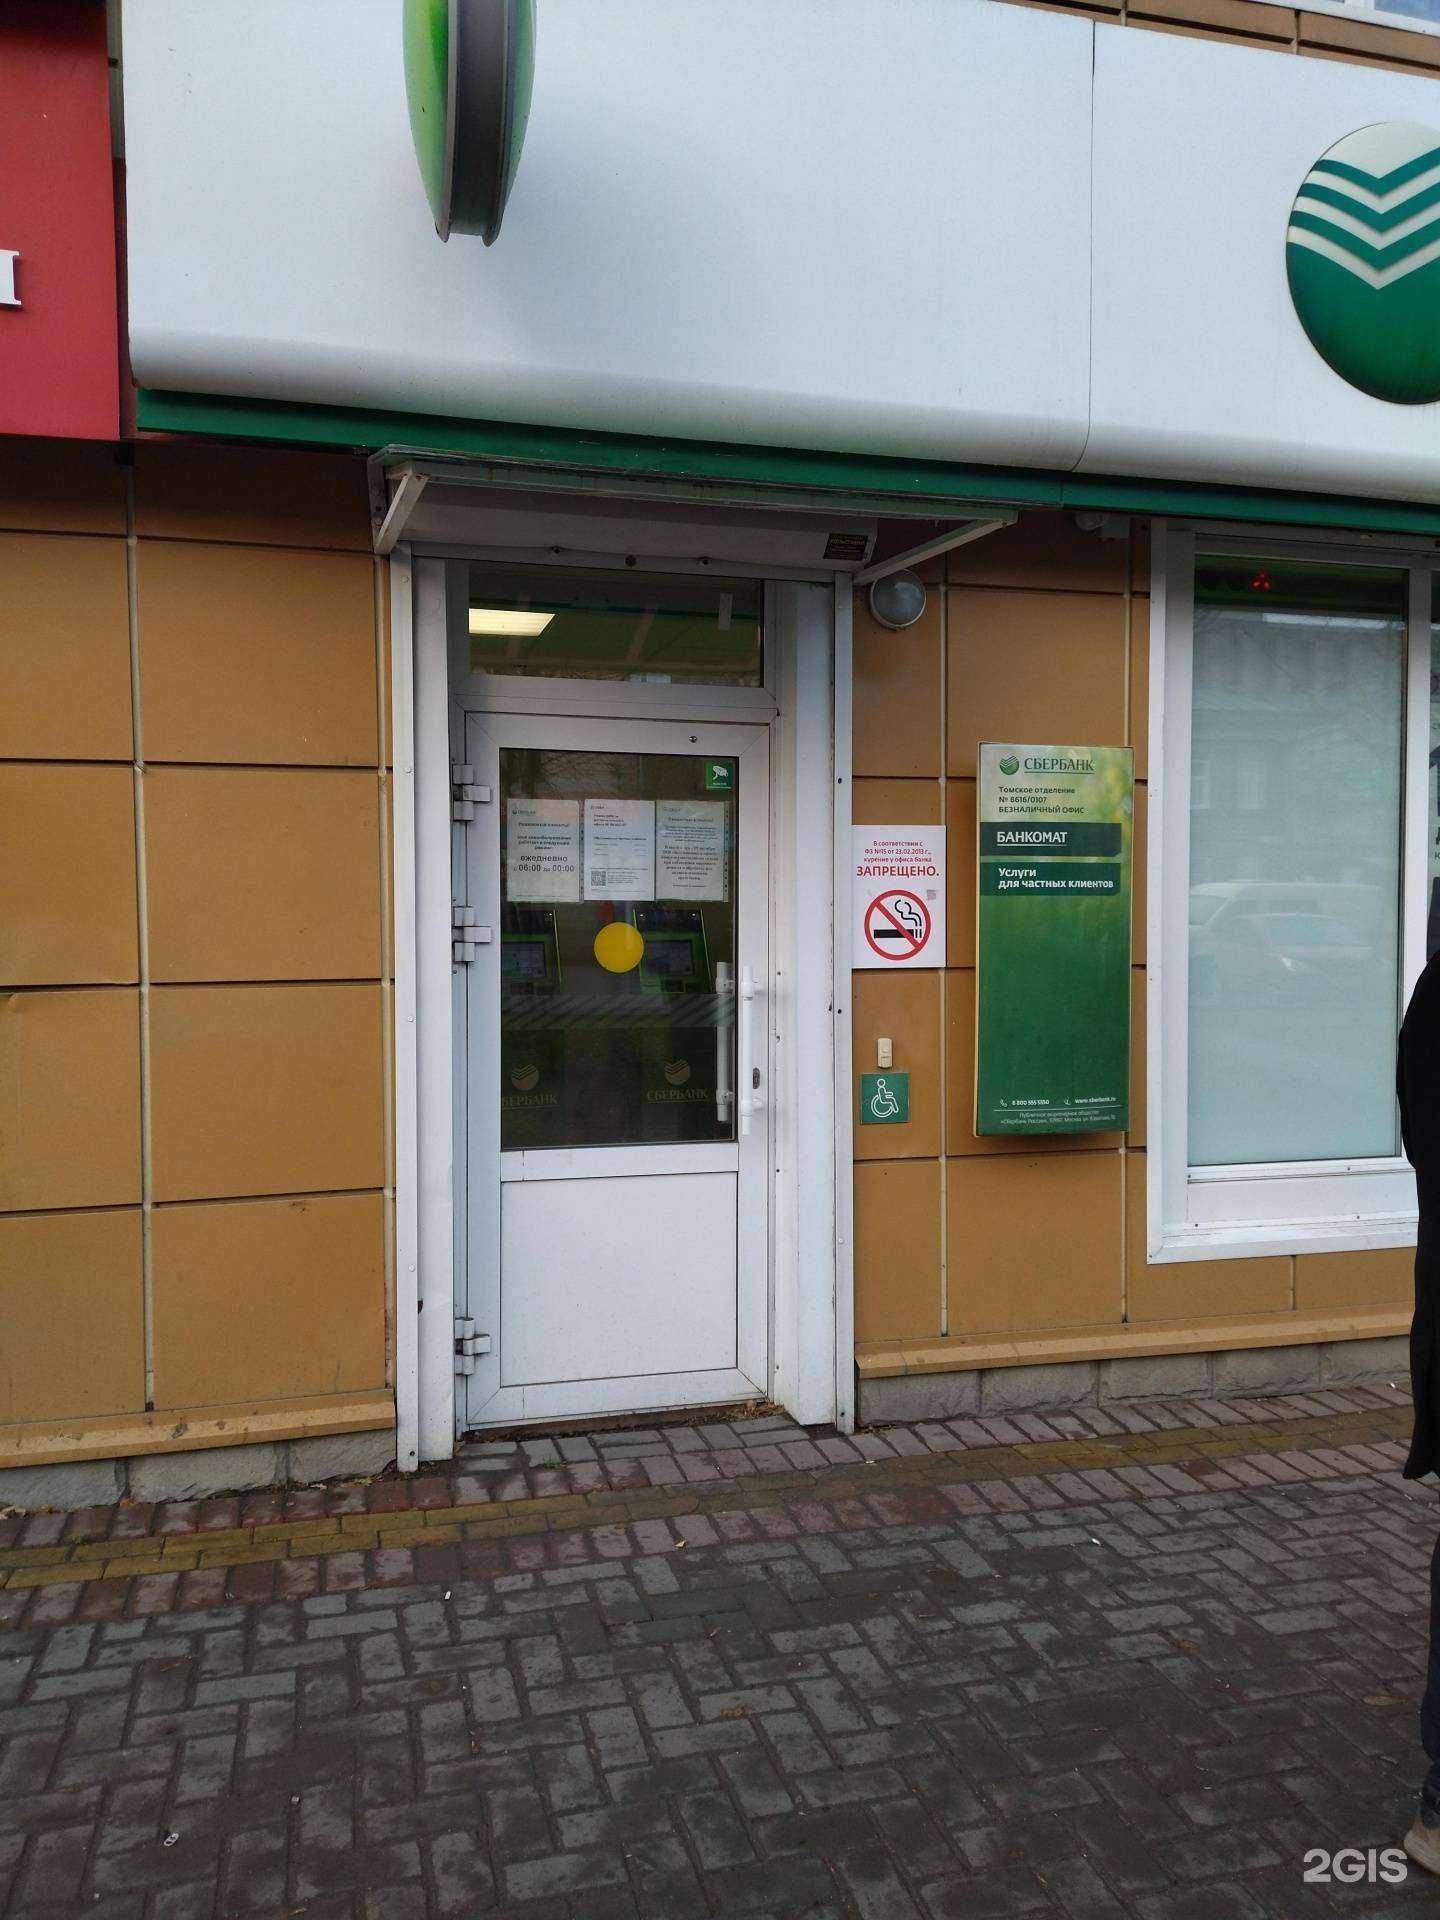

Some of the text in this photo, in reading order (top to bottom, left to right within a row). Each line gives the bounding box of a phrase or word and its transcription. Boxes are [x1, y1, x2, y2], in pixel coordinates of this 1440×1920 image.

[1024, 757, 1095, 772] СБЕРБАНК
[998, 805, 1085, 814] БЕЗНАЛИЧНЫЙ ОФИС
[997, 831, 1068, 843] БАНКОМАТ
[894, 856, 914, 864] офиса
[857, 865, 940, 879] ЗАПРЕЩЕНО.
[998, 867, 1037, 879] Услуги
[998, 879, 1114, 889] для частных клиентов
